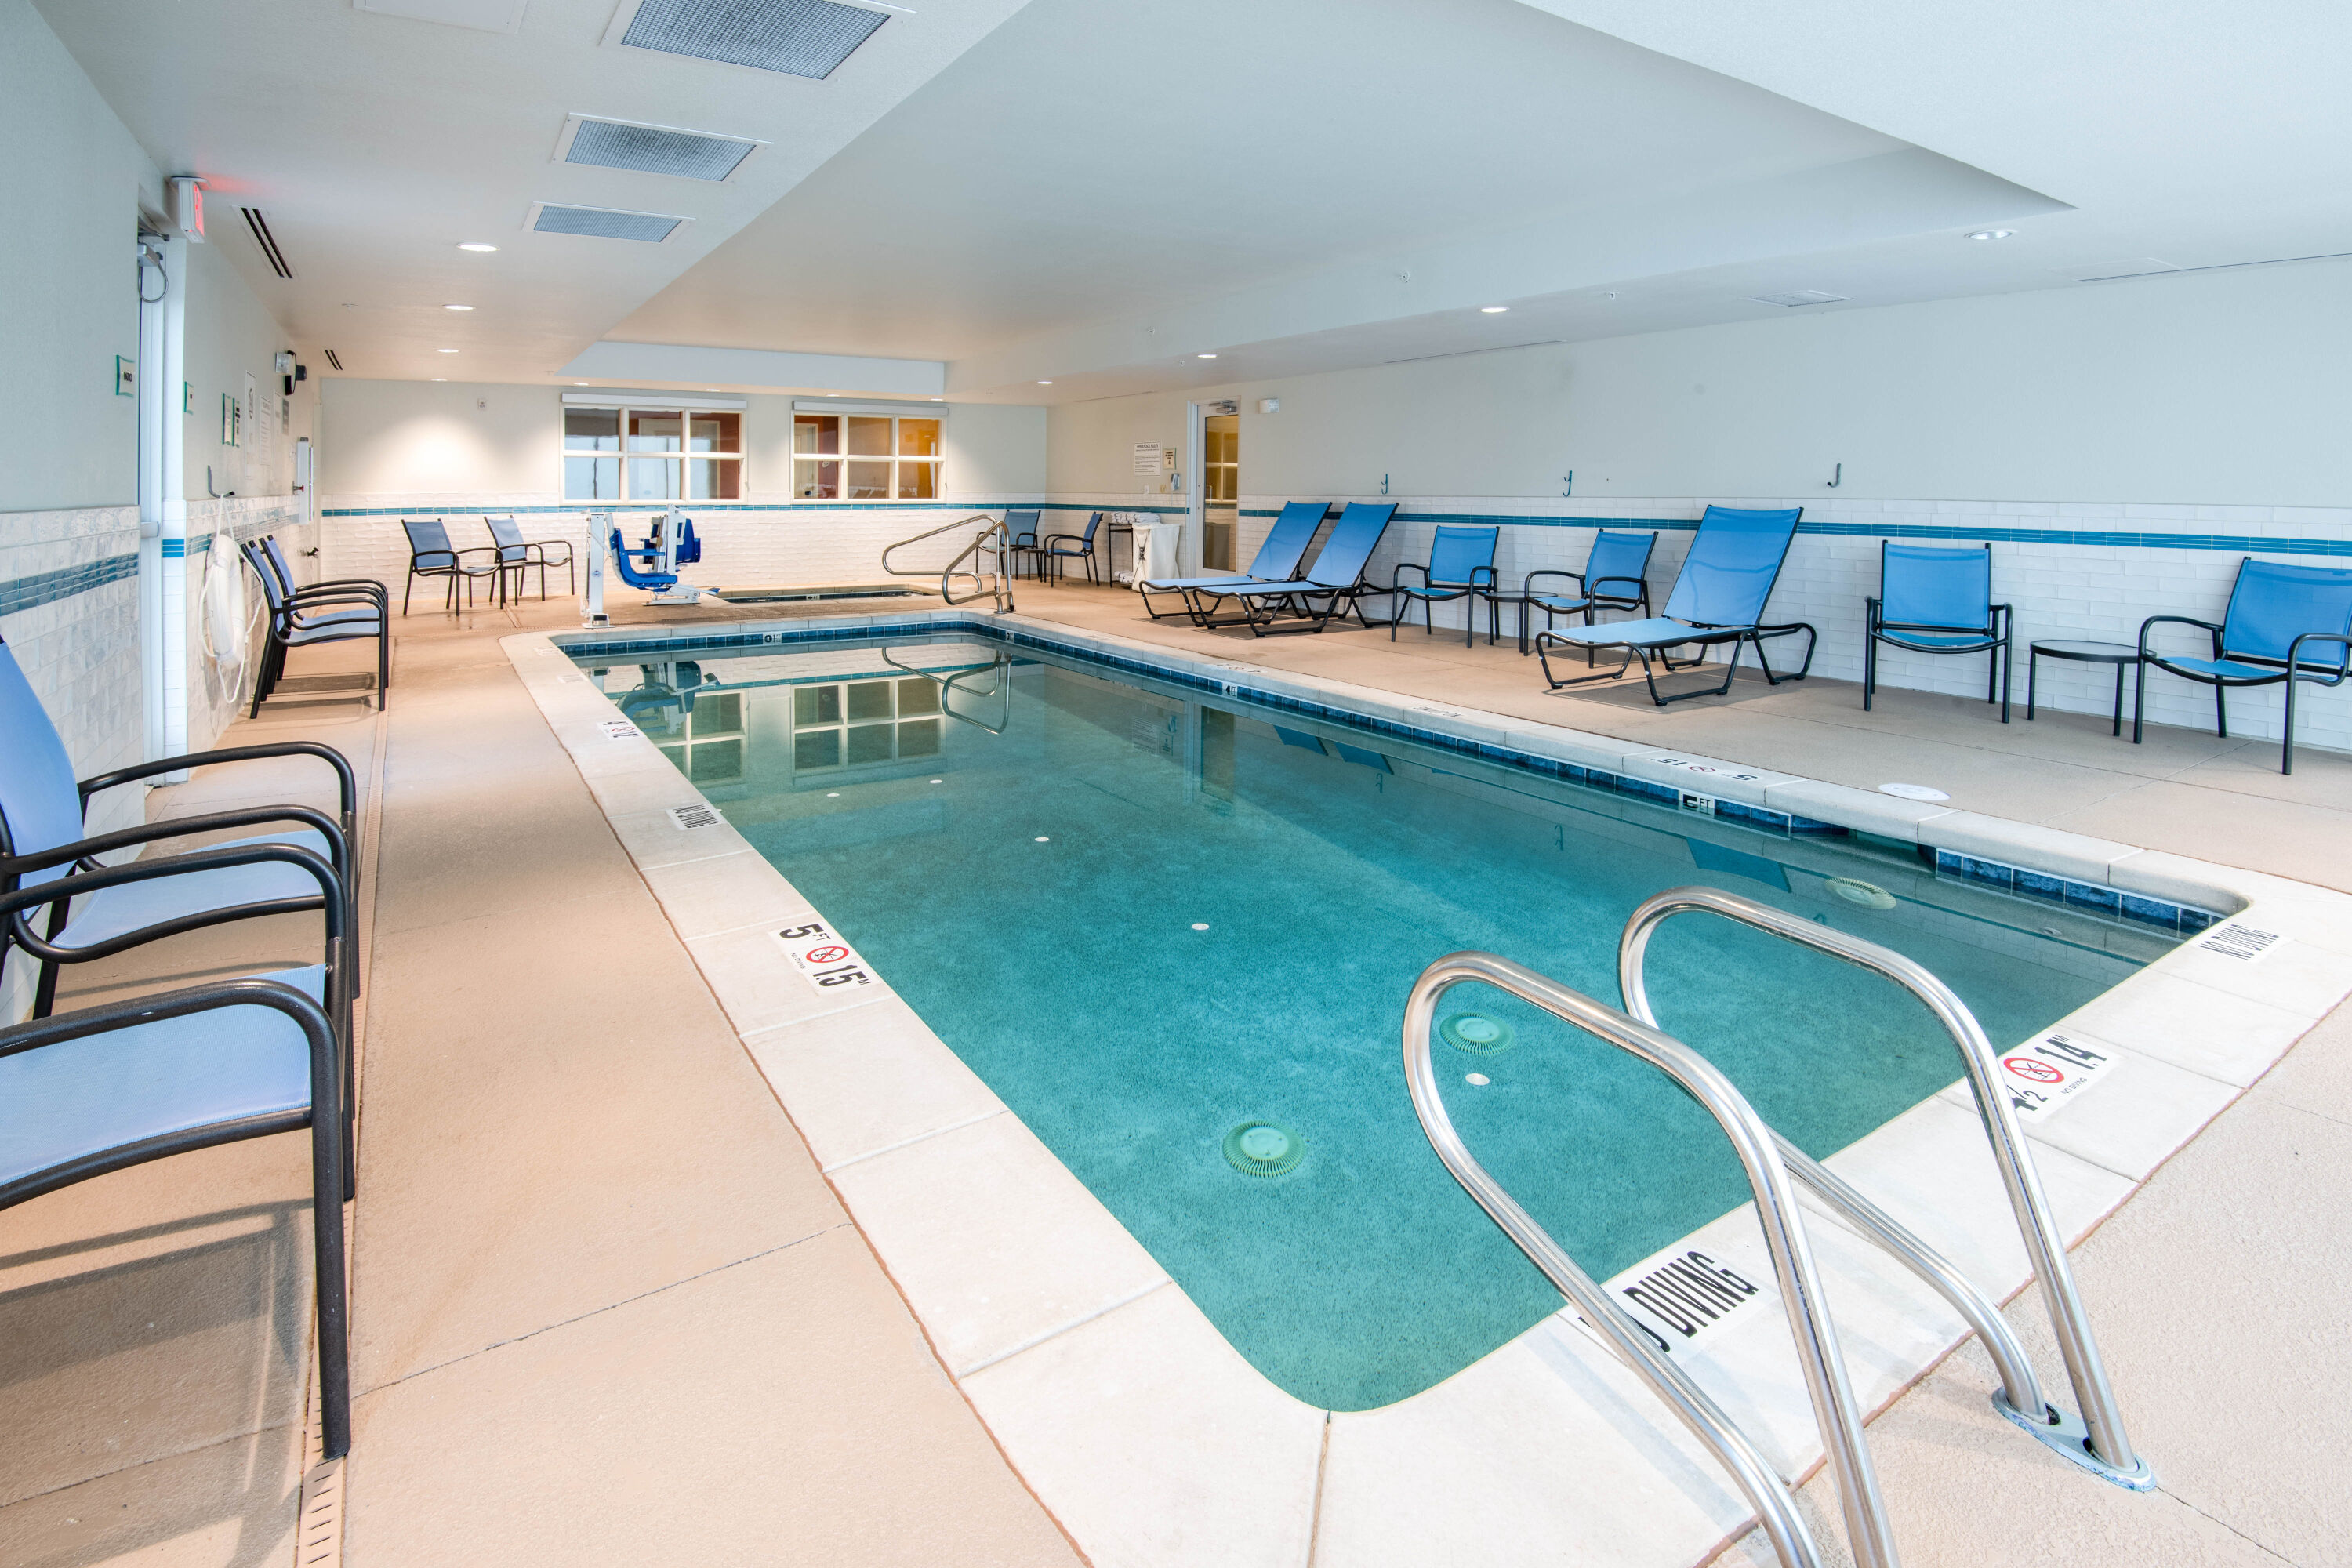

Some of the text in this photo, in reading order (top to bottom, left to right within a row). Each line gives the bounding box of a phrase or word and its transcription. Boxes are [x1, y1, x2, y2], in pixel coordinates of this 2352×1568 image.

[779, 924, 824, 939] 5
[2198, 924, 2279, 960] NO DIVING
[1622, 1251, 1759, 1338] DIVING
